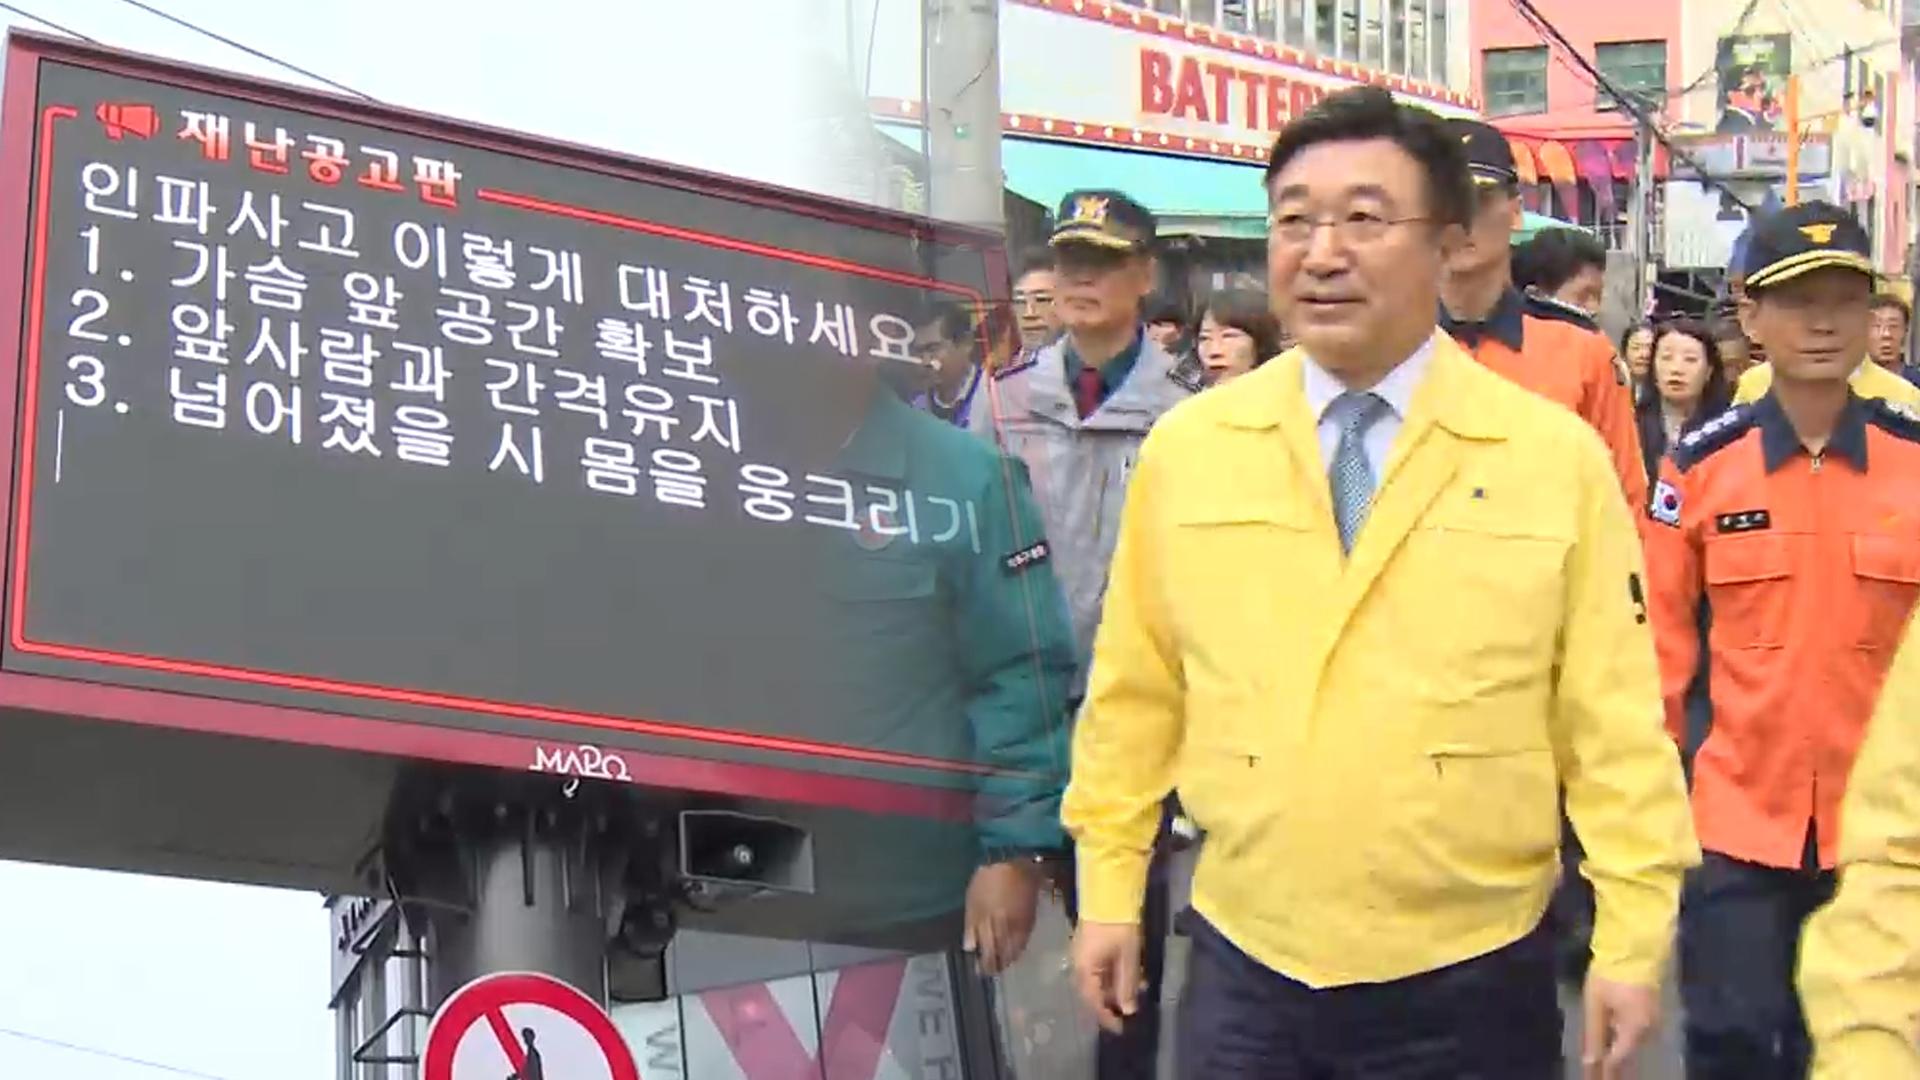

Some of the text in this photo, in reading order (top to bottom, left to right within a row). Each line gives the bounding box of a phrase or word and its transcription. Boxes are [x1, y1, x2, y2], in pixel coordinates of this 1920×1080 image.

[177, 108, 462, 207] 재난공고판
[1140, 48, 1329, 132] BATTER
[80, 225, 720, 385] 1. 가슴 앞 공간 확보
[82, 161, 360, 258] 인파사고
[394, 221, 584, 304] 이렇게
[68, 288, 742, 453] 2. 앞사람과 간격유지
[65, 354, 983, 555] 3. 넘어졌을 시 몸을 웅크리기
